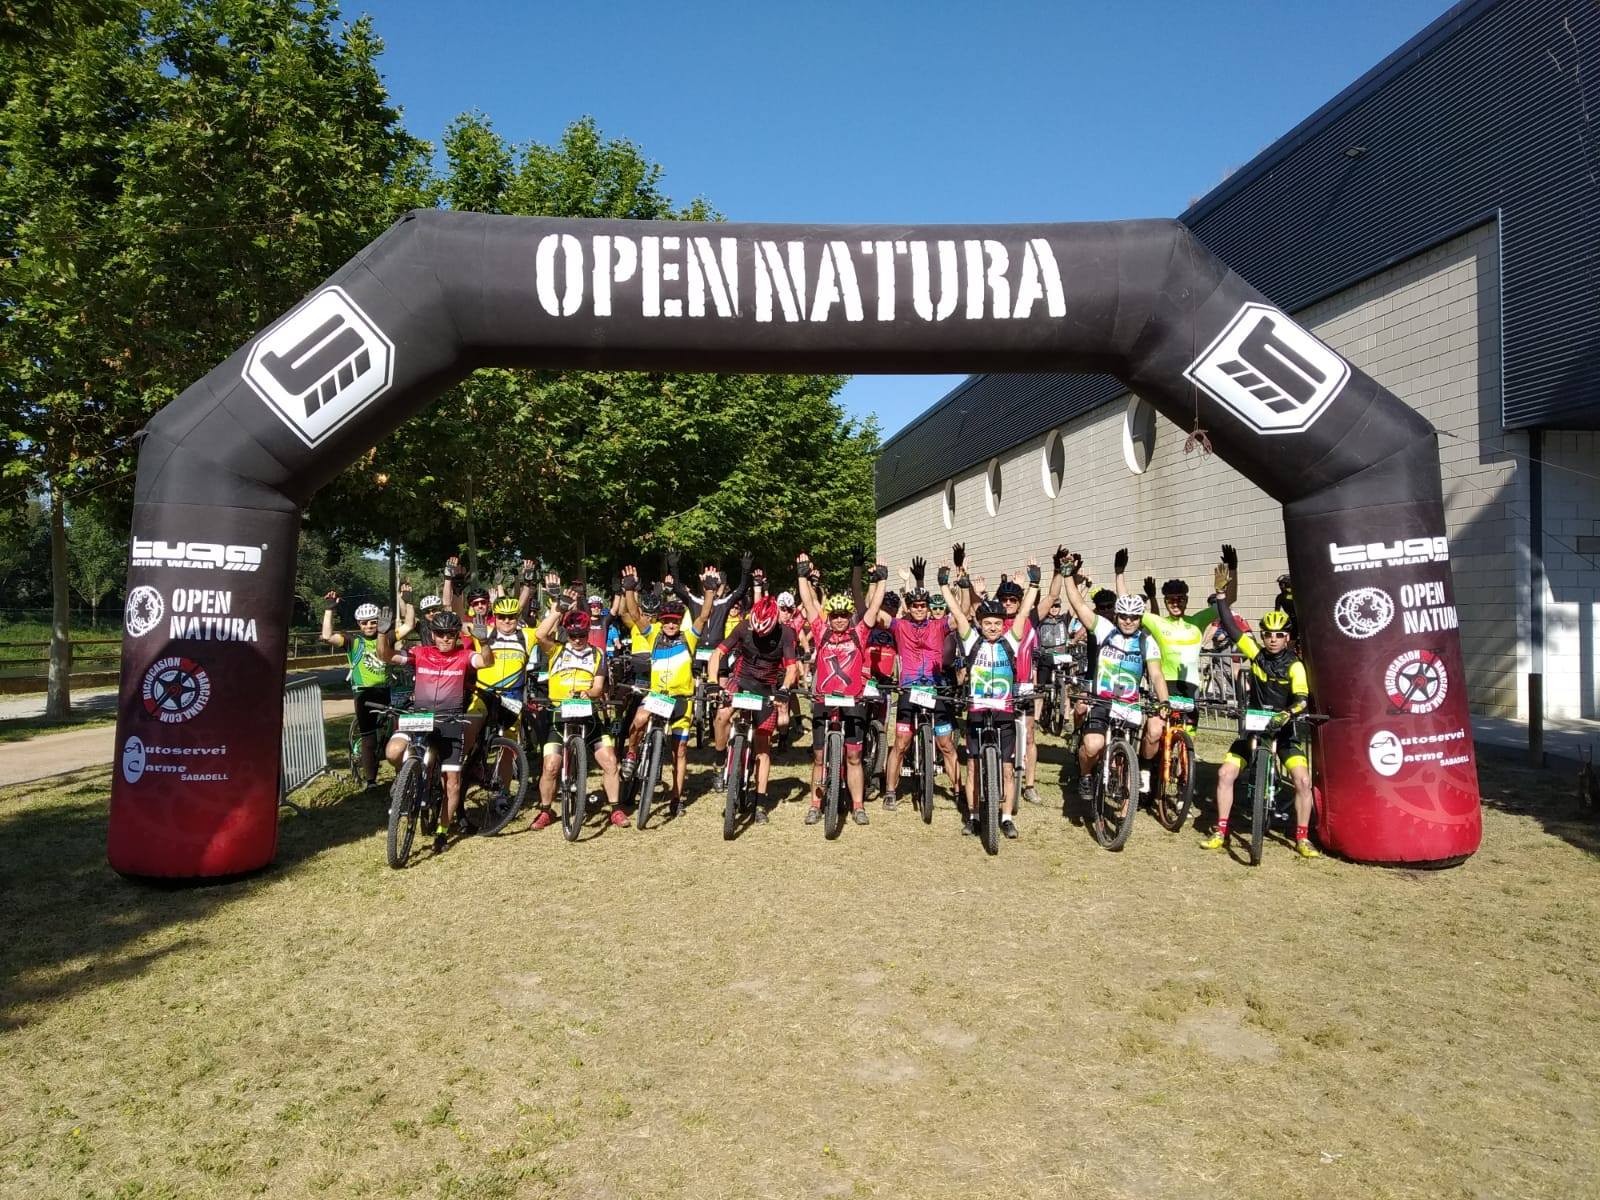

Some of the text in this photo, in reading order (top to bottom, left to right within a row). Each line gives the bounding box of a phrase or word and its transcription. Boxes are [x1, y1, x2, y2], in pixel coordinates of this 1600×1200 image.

[535, 233, 1067, 322] OPEN NATURA
[132, 559, 214, 570] ACTIVE WEAR
[1334, 555, 1429, 573] ACTIVE WEAR
[172, 588, 232, 614] OPEN
[1400, 581, 1446, 608] OPEN
[169, 615, 258, 642] NATURA
[143, 657, 181, 700] BICIOCASION
[1385, 649, 1421, 696] BICIOCASION
[1369, 728, 1465, 748] Autoservei
[124, 742, 227, 755] Autoservei
[1380, 751, 1444, 765] Carme
[128, 760, 188, 773] Carme
[1440, 755, 1470, 767] SABADELL
[180, 773, 229, 781] SABADELL
